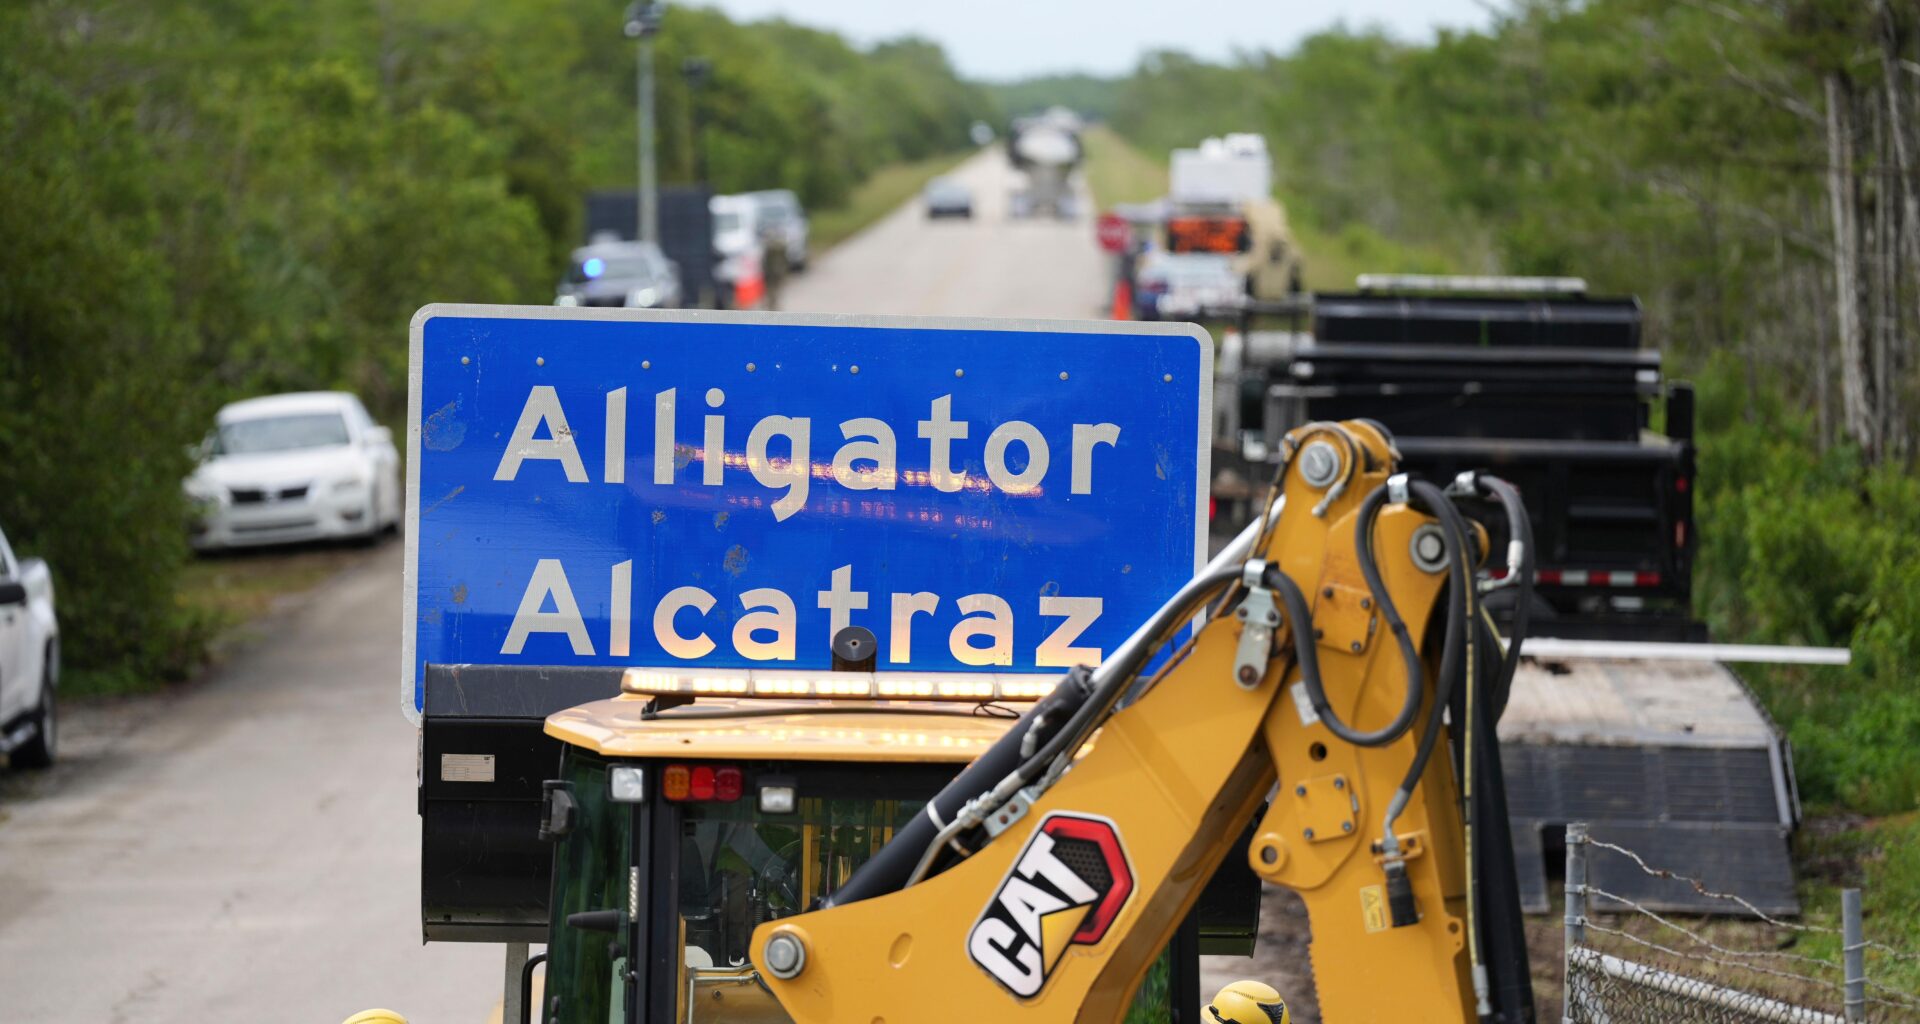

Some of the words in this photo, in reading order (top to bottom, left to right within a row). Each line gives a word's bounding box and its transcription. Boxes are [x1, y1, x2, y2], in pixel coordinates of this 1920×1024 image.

[493, 385, 1121, 522] Alligator
[500, 558, 1103, 667] Alcatraz
[969, 831, 1099, 996] CAT
